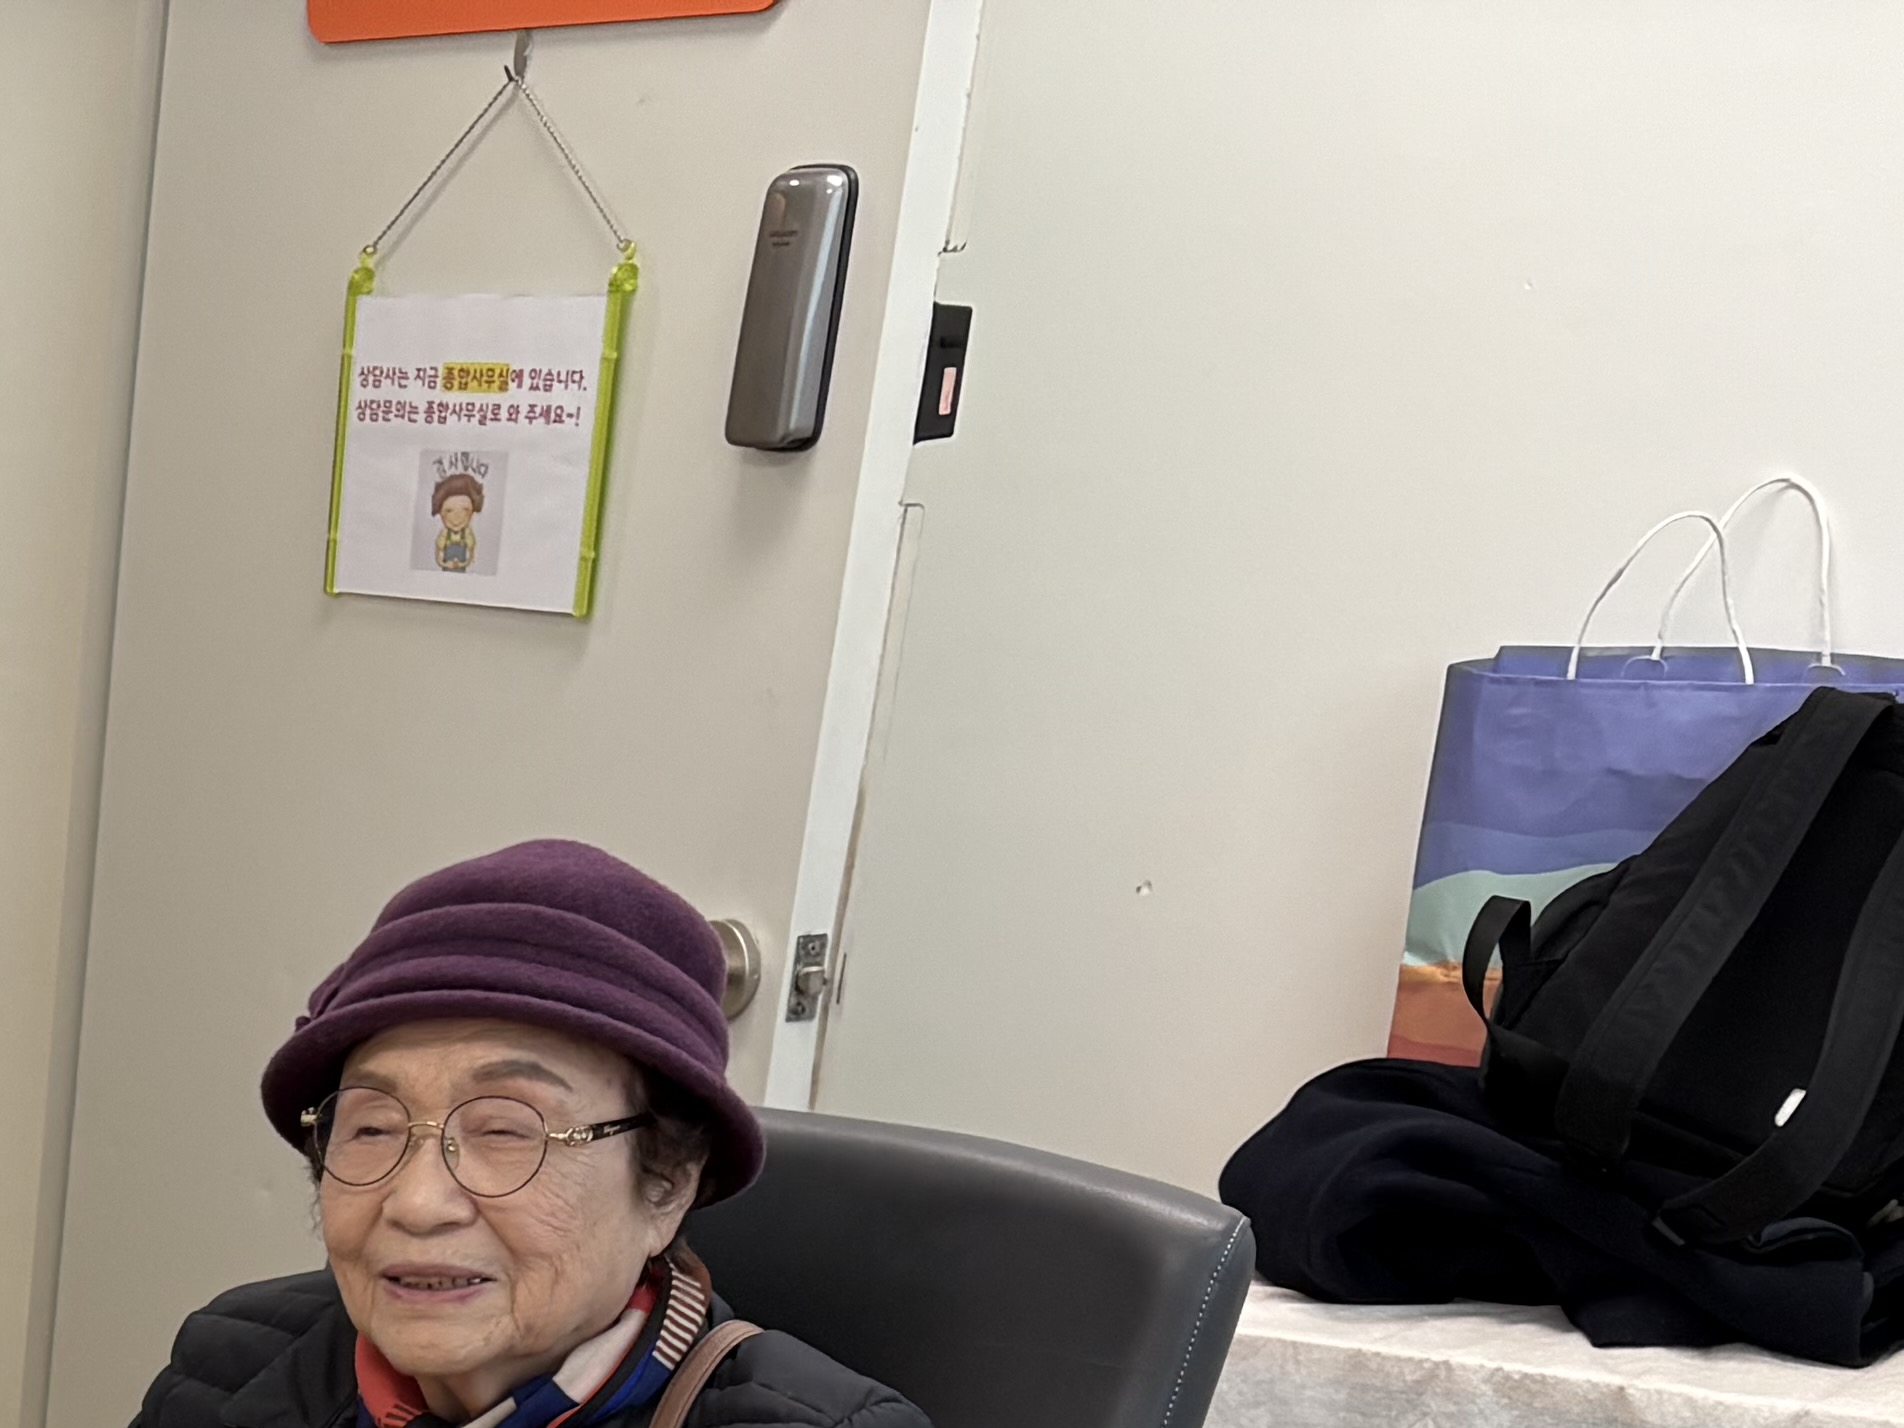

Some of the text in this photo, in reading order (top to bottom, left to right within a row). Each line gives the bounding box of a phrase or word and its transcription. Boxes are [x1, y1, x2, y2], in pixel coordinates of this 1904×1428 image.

[358, 365, 588, 393] 상담사는 지금 종합사무실에 있습니다.
[355, 399, 419, 423] 상담문의는
[423, 401, 502, 427] 종합사무실로
[506, 404, 521, 424] 와
